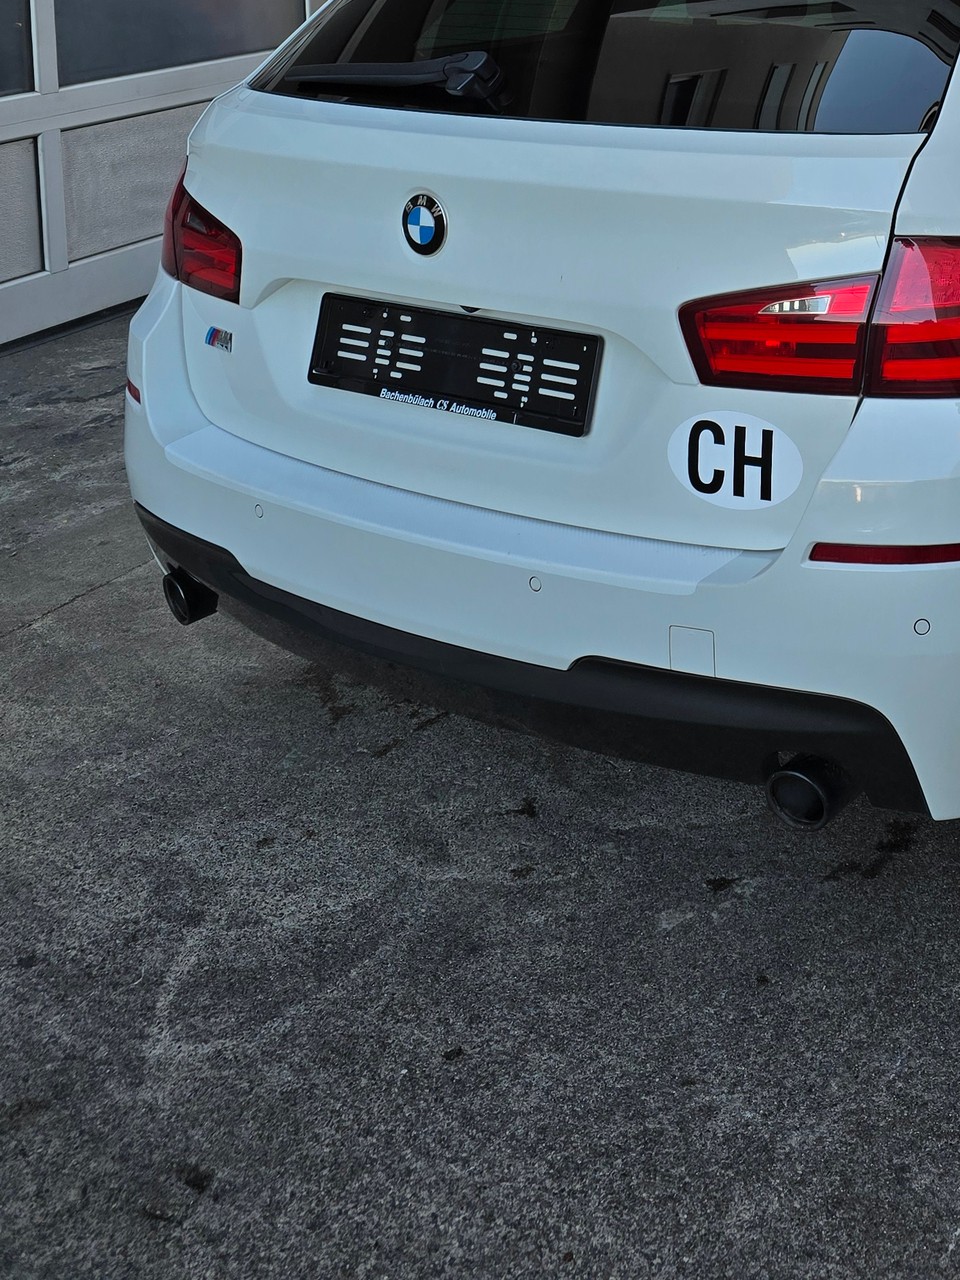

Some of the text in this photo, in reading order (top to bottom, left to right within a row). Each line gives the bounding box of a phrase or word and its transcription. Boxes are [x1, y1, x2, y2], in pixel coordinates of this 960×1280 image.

[405, 195, 442, 217] BMW
[380, 388, 497, 420] Bachenbülach CS Automobile
[688, 420, 773, 501] CH
